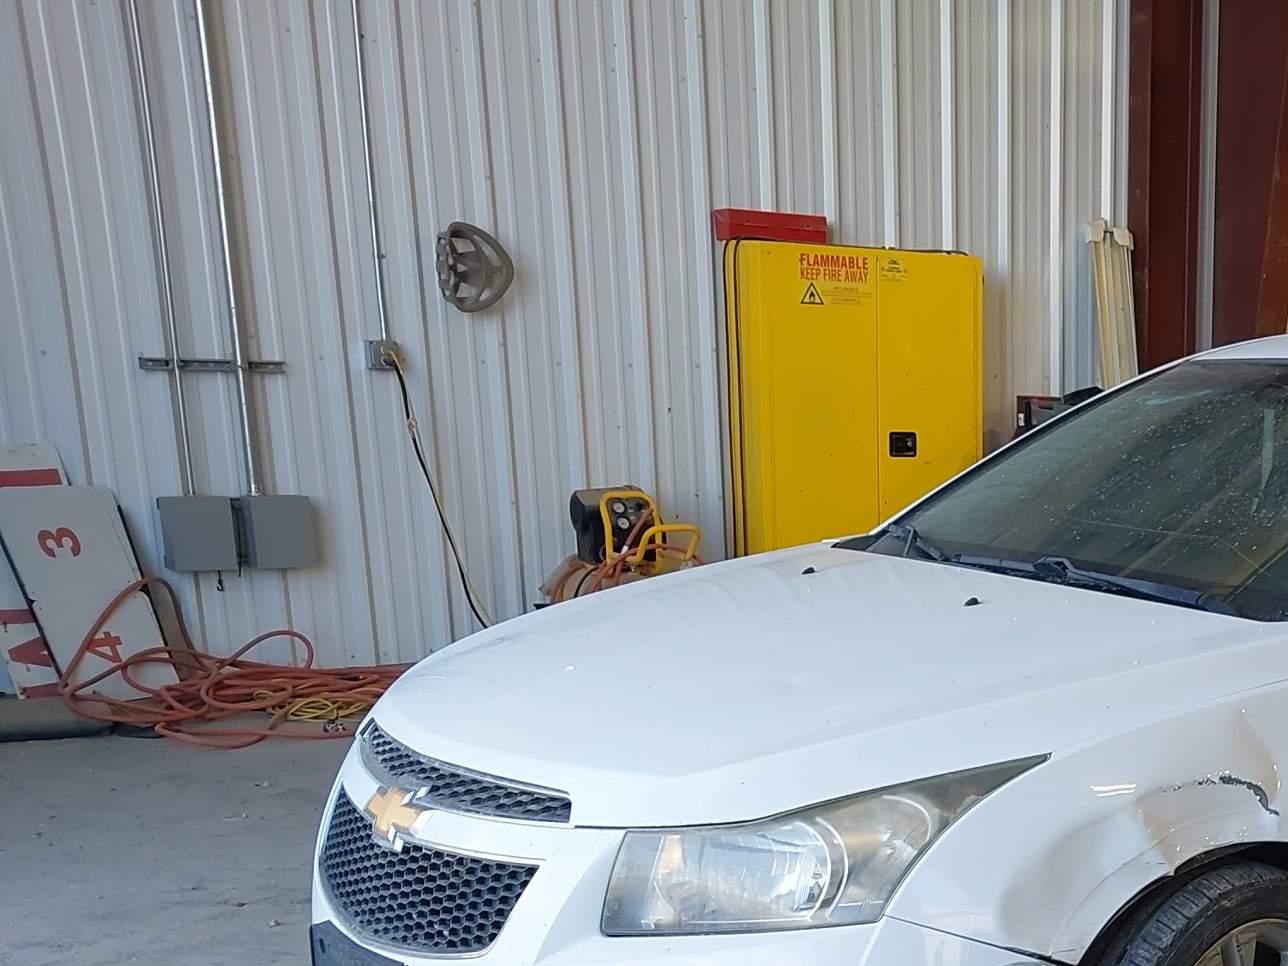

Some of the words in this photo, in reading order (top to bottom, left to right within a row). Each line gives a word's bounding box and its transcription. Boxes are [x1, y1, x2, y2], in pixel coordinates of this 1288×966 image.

[800, 253, 868, 270] FLAMMABLE
[800, 267, 821, 280] KEEP
[823, 268, 843, 282] FIRE
[844, 269, 868, 284] AWAY
[37, 527, 81, 558] 3
[86, 631, 122, 663] 4
